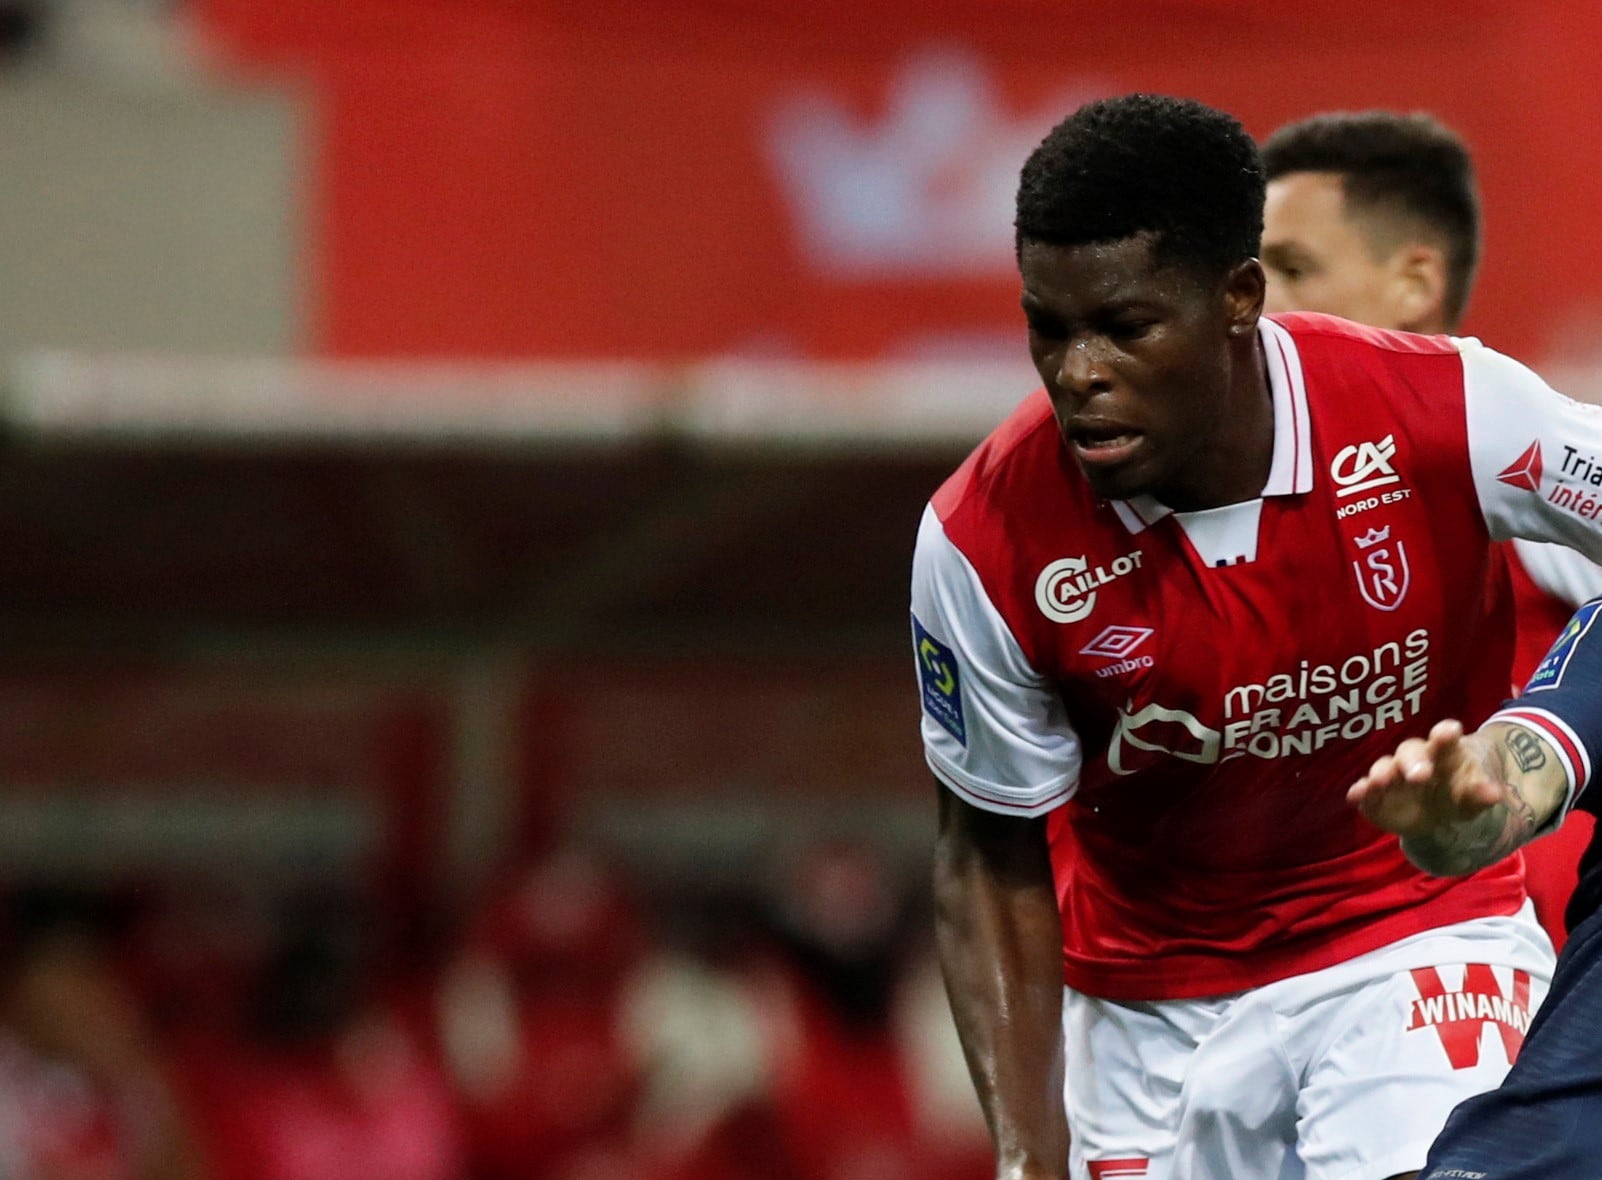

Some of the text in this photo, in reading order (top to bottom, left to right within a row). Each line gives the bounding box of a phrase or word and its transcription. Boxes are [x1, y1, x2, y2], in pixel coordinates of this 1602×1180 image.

[1336, 489, 1412, 520] NORD EST
[1034, 550, 1143, 624] CAILLOT
[1096, 655, 1154, 678] umbro
[1224, 628, 1429, 718] maisons
[1224, 656, 1428, 749] FRANCE
